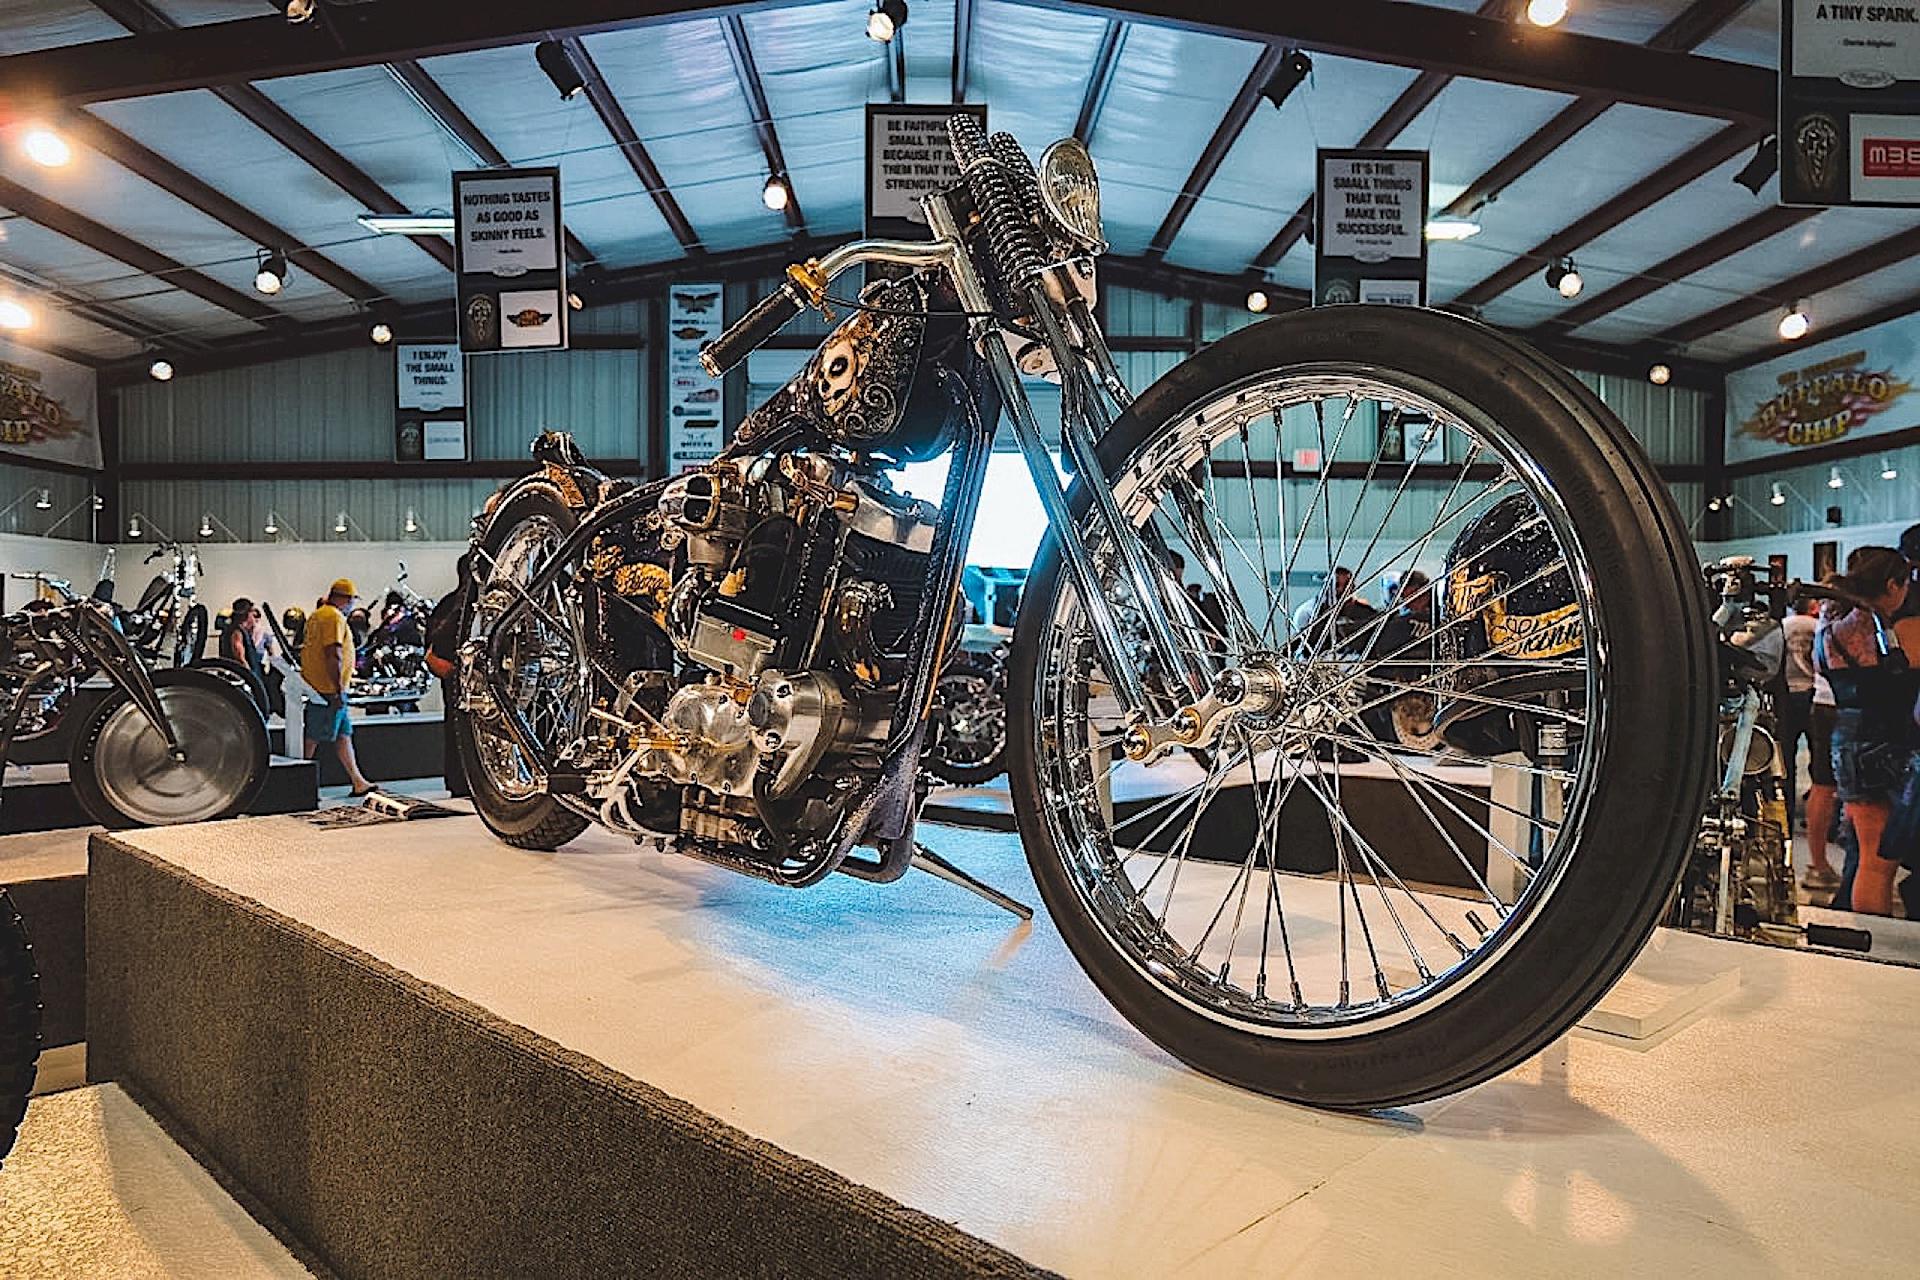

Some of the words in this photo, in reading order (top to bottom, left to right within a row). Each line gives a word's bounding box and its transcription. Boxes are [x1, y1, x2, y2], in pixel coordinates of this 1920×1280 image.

[1817, 5, 1827, 19] A
[1831, 5, 1863, 21] TINY
[1867, 7, 1919, 22] SPARK.
[888, 121, 901, 131] BE
[889, 135, 923, 145] SMALL
[884, 150, 929, 160] BECAUSE
[933, 150, 942, 160] IT
[883, 165, 912, 174] THEM
[914, 165, 939, 175] THAT
[1351, 163, 1372, 174] IT'S
[1375, 163, 1395, 175] THE
[1334, 177, 1369, 189] SMALL
[1374, 178, 1411, 190] THINGS
[464, 193, 510, 206] NOTHING
[511, 191, 551, 203] TASTES
[1345, 193, 1371, 204] THAT
[1375, 193, 1400, 205] WILL
[476, 211, 491, 223] AS
[493, 210, 523, 222] GOOD
[525, 210, 539, 221] AS
[1345, 208, 1375, 219] MAKE
[1379, 208, 1400, 220] YOU
[1336, 223, 1408, 235] SUCCESSFUL.
[471, 230, 509, 241] SKINNY
[419, 351, 448, 360] ENJOY
[406, 364, 422, 372] THE
[424, 363, 455, 372] SMALL
[1788, 410, 1851, 445] CHIP
